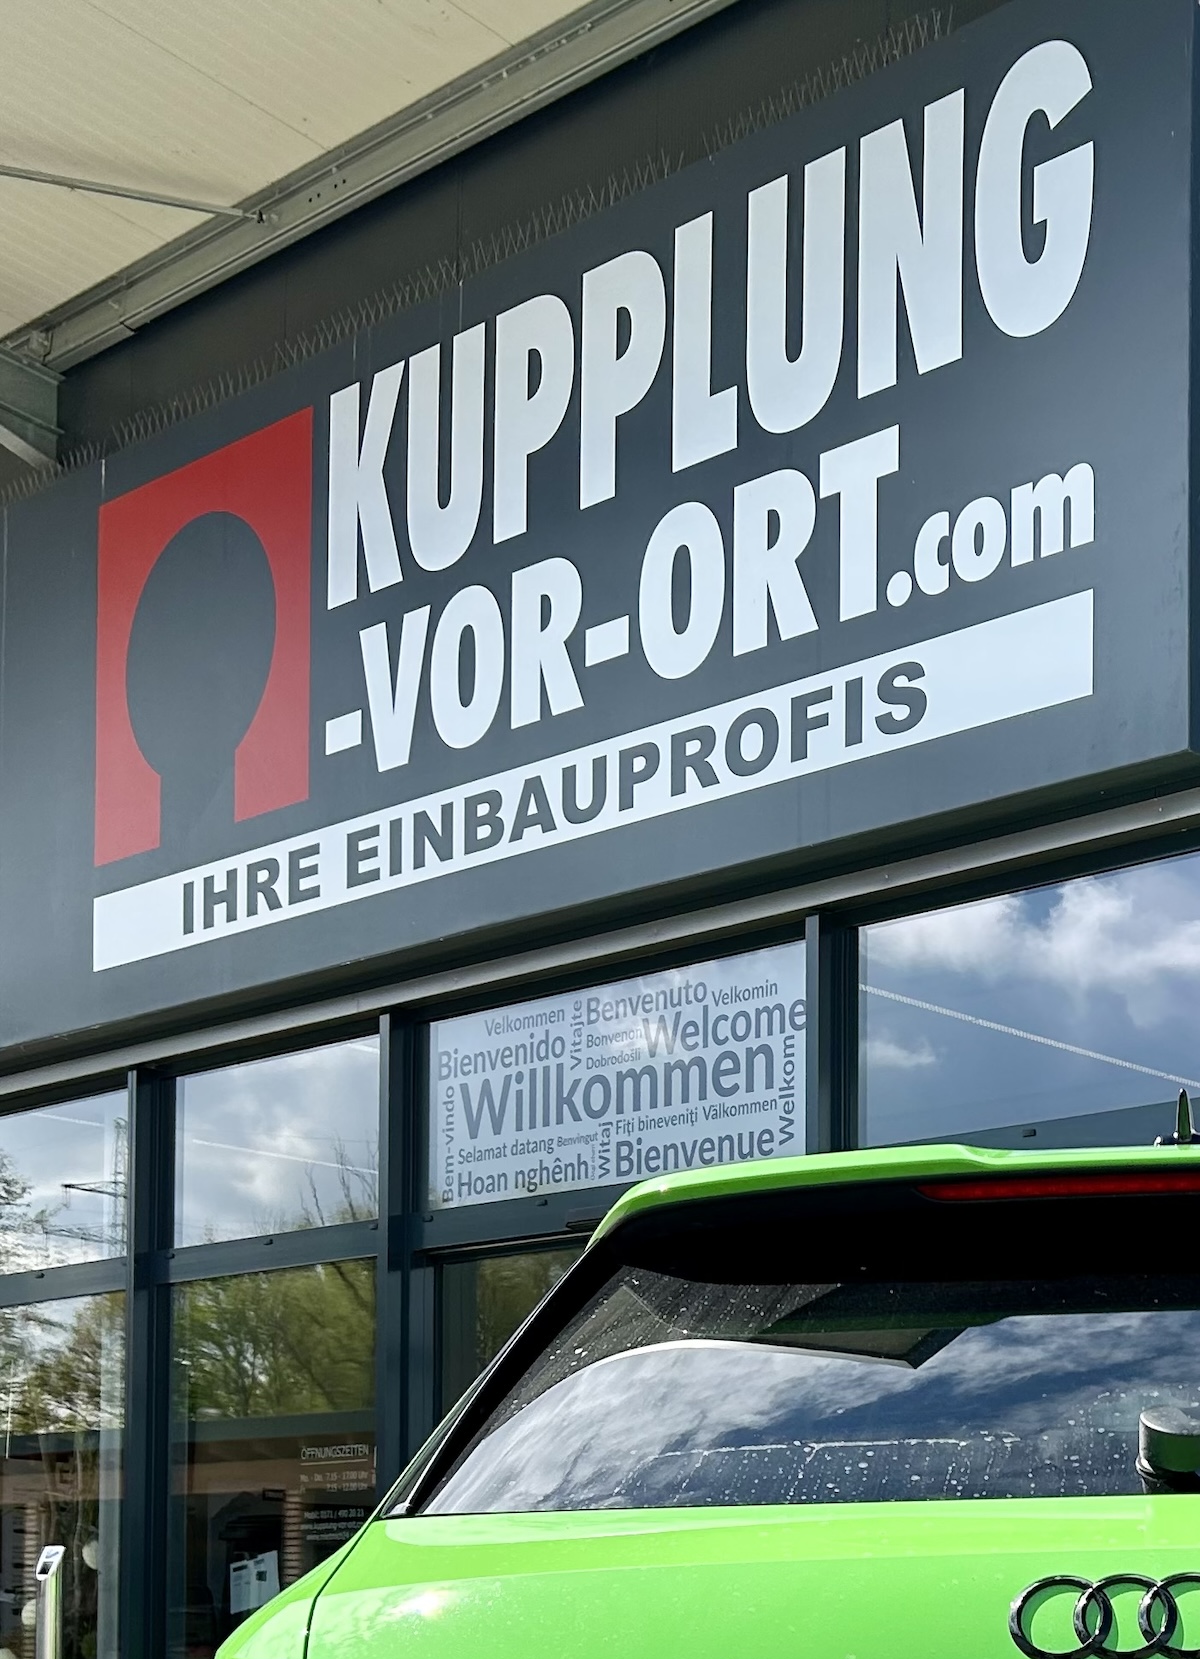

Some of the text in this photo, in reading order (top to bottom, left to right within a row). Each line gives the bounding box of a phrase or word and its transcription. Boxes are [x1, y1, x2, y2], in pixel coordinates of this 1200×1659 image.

[327, 39, 1094, 610] KUPPLUNG
[325, 424, 1095, 772] -VOR-ORT.com
[183, 660, 928, 936] IHRE EINBAUPROFIS
[586, 980, 708, 1026] Benvenuto
[712, 979, 778, 1007] Velkomin
[484, 1008, 565, 1037] Velkommen
[570, 1000, 584, 1071] Vitajte
[586, 1027, 643, 1049] Bonvenon
[642, 998, 807, 1059] Welcome
[438, 1029, 566, 1082] Bienvenido
[586, 1047, 641, 1070] Dobrodošli
[459, 1043, 775, 1140] Willkommen
[779, 1034, 795, 1146] Welkom
[442, 1086, 455, 1203] Bem-vindo
[458, 1136, 554, 1165] Selamat datang
[557, 1131, 598, 1148] Benvingut
[598, 1121, 613, 1180] Witaj
[616, 1128, 775, 1178] Bienvenue
[458, 1170, 508, 1198] Hoan
[515, 1153, 589, 1193] nghênh
